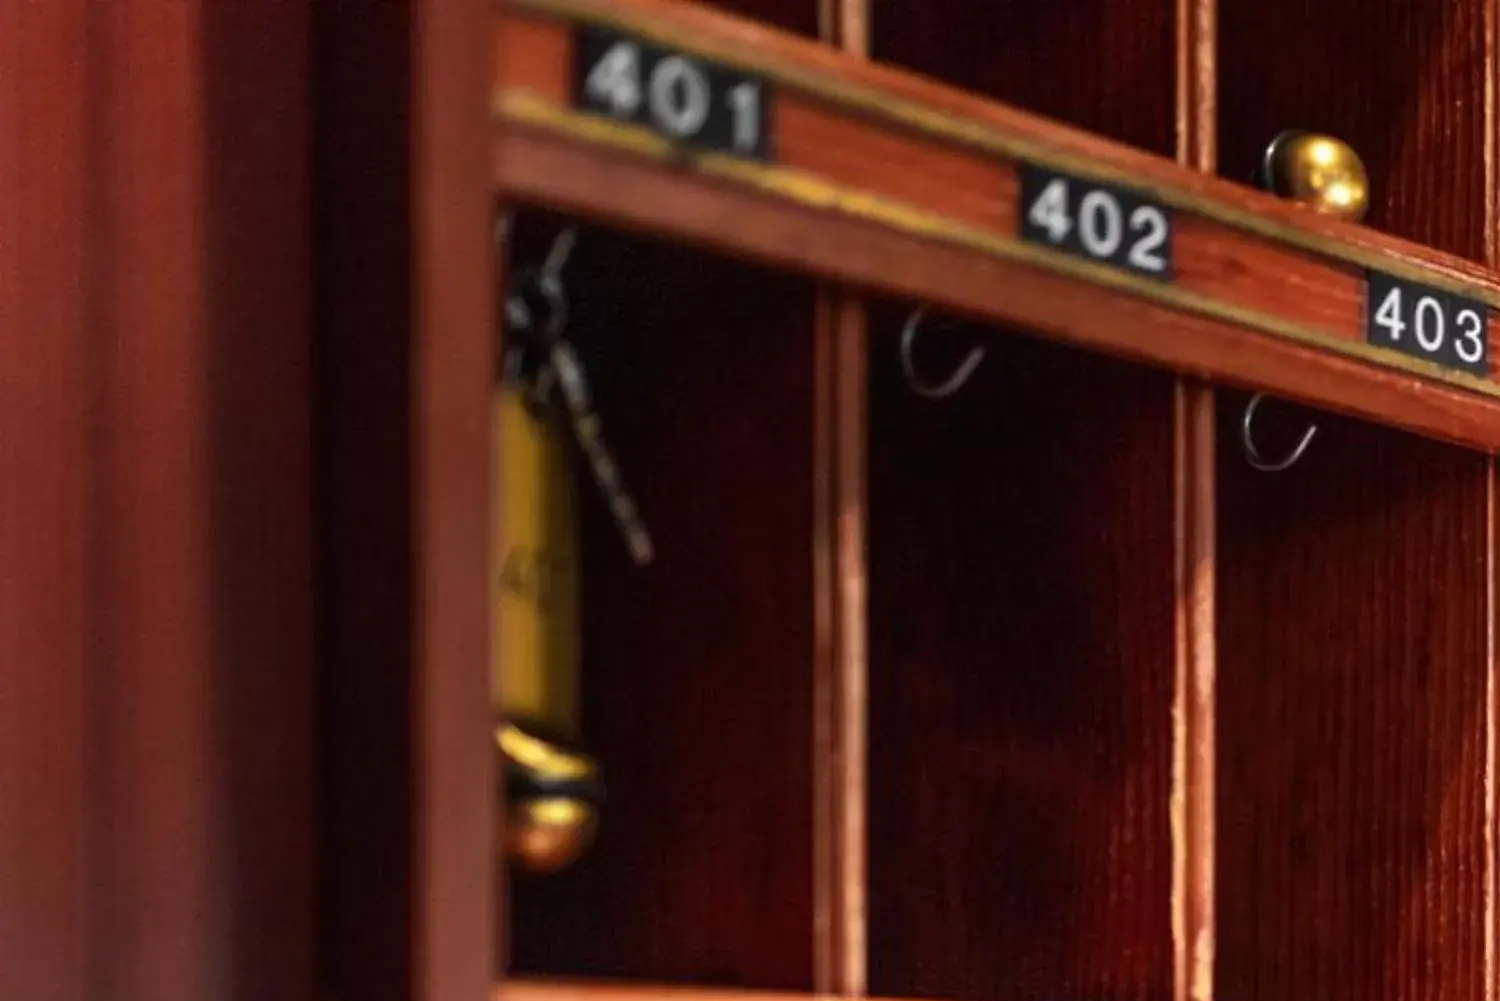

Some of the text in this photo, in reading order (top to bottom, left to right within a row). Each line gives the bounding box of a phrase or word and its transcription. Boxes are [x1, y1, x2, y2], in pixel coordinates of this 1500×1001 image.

[586, 41, 760, 152] 401
[1029, 178, 1168, 271] 402
[1375, 286, 1484, 363] 403
